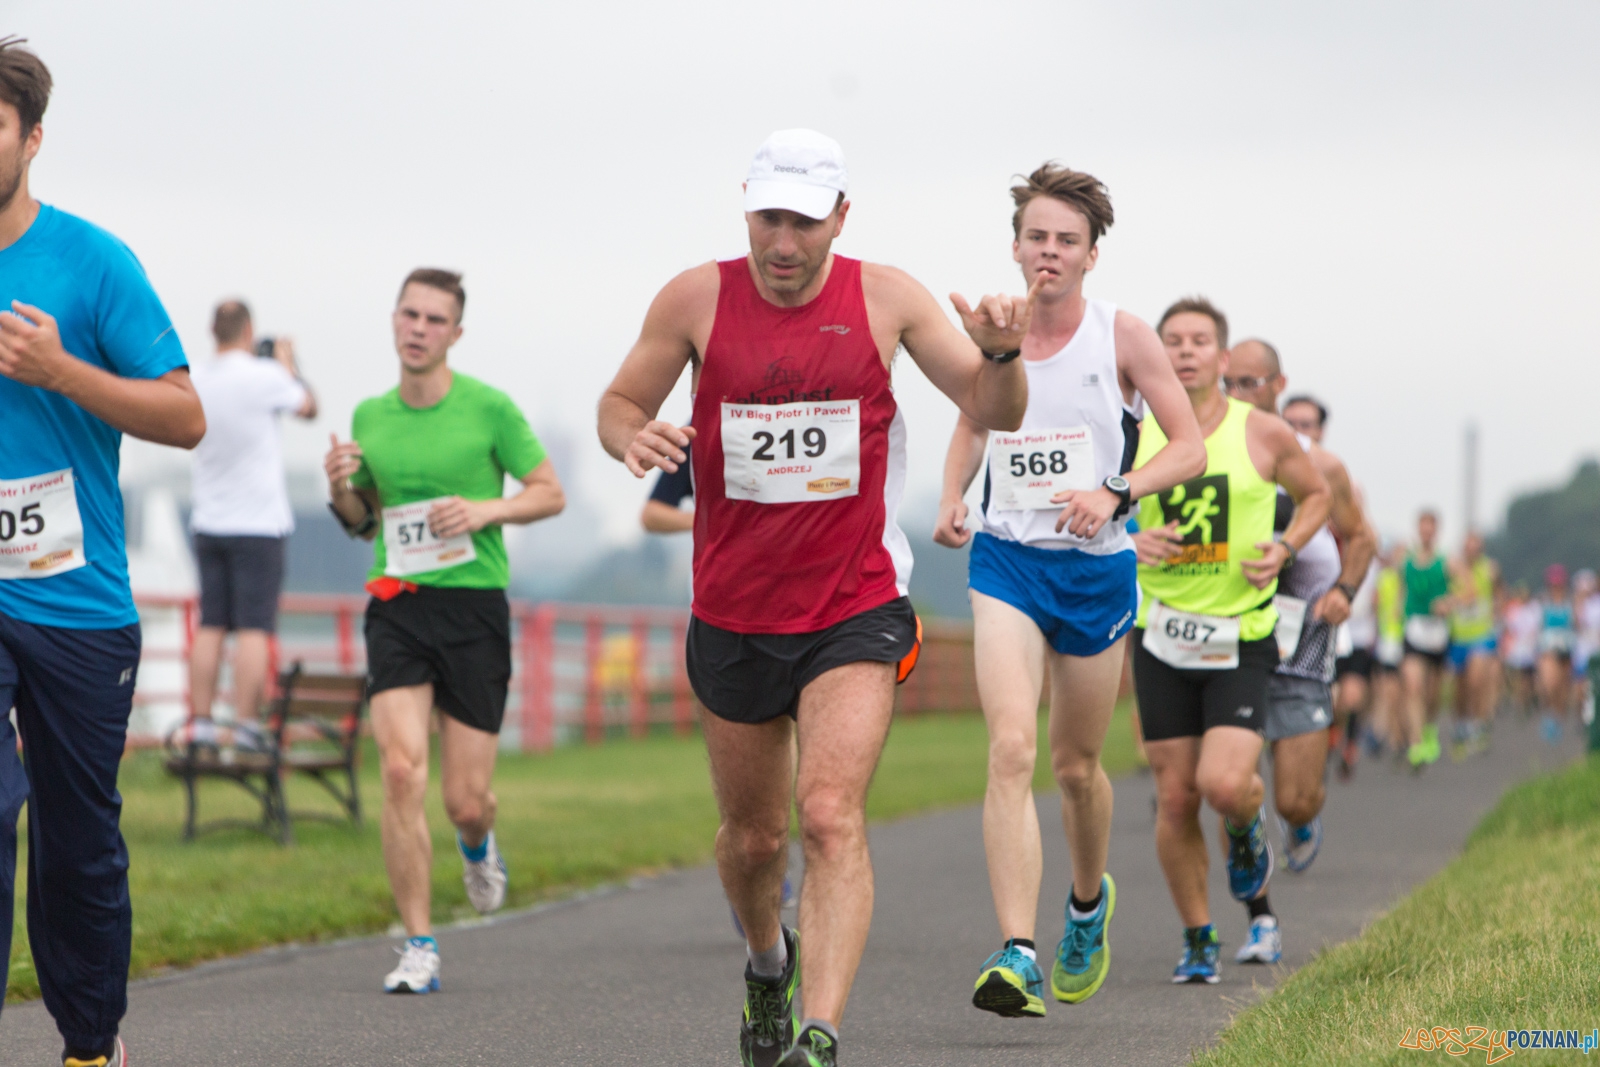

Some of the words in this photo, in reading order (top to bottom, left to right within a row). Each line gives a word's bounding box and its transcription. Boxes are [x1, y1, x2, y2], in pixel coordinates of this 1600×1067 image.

[773, 164, 809, 176] Reebok
[730, 408, 743, 418] IV
[746, 409, 772, 423] Bieg
[775, 408, 803, 420] Piotr
[806, 407, 810, 417] i
[814, 405, 851, 416] Paweł
[751, 426, 827, 462] 219
[766, 465, 813, 476] ANDRZEJ
[1010, 449, 1068, 478] 568
[0, 501, 45, 541] 05
[1164, 617, 1217, 644] 687
